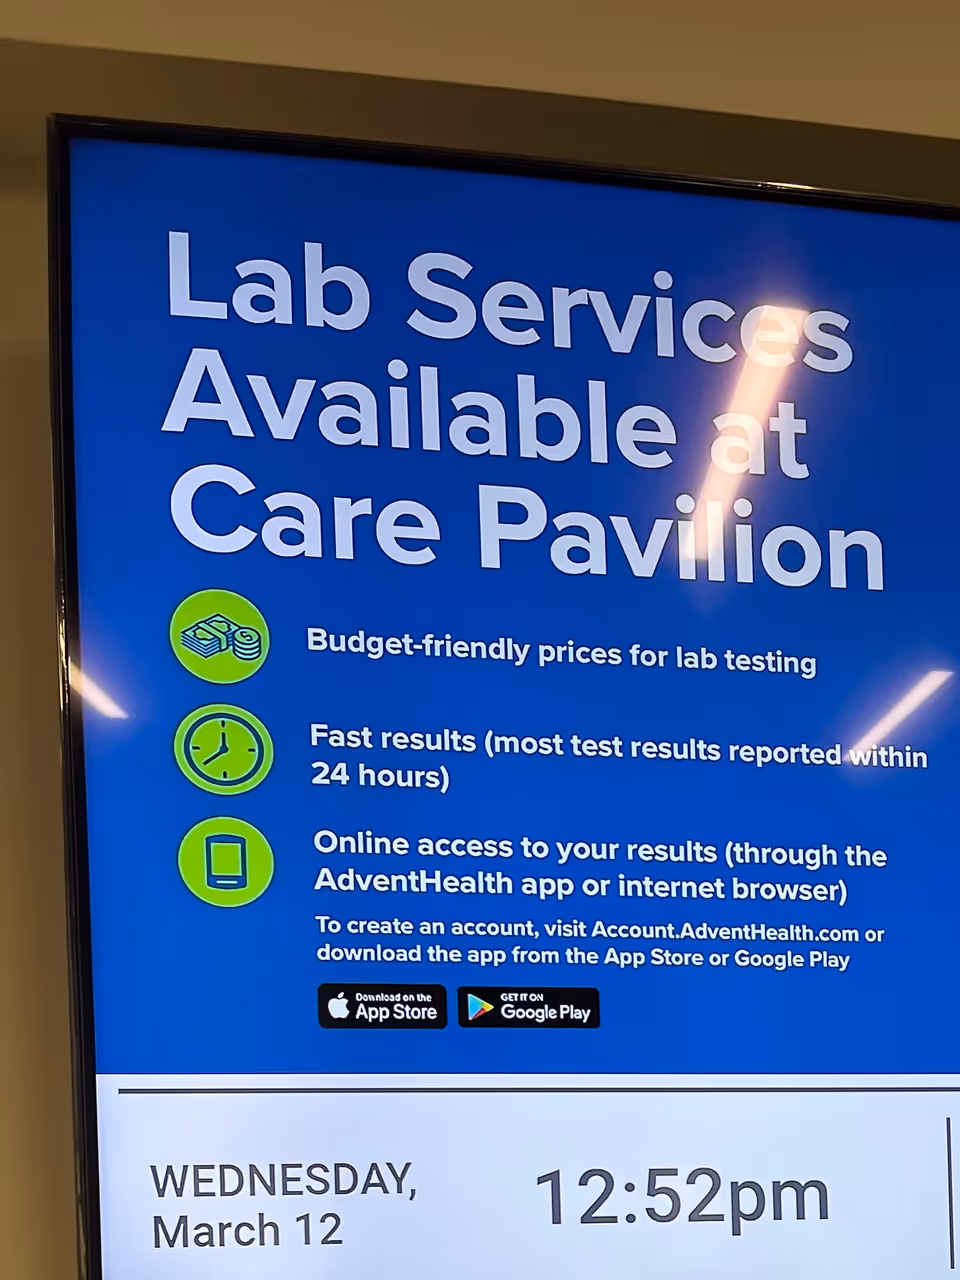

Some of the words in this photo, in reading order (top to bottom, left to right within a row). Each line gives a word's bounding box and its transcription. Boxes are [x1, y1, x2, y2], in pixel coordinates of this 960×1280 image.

[168, 231, 370, 331] Lab
[407, 253, 854, 373] Services
[161, 349, 677, 469] Available
[711, 402, 809, 479] at
[170, 463, 441, 566] Care
[478, 484, 884, 591] Pavilion
[306, 628, 531, 666] Budget-friendly
[539, 639, 622, 669] prices
[629, 642, 669, 668] for
[676, 644, 718, 670] lab
[724, 649, 818, 680] testing
[310, 723, 374, 750] Fast
[381, 728, 477, 754] results
[484, 729, 564, 759] (most
[570, 734, 623, 759] test
[630, 734, 721, 762] results
[728, 739, 842, 768] reported
[849, 742, 928, 769] within
[311, 761, 350, 785] 24
[358, 762, 451, 794] hours)
[313, 830, 409, 855] Online
[417, 838, 513, 858] access
[521, 839, 550, 859] to
[556, 842, 620, 865] your
[627, 841, 717, 864] results
[724, 841, 838, 871] (through
[844, 846, 888, 868] the
[313, 868, 513, 895] AdventHealth
[521, 877, 574, 901] app
[582, 879, 612, 898] or
[618, 875, 725, 900] internet
[732, 877, 848, 906] browser)
[315, 916, 340, 934] To
[346, 918, 414, 936] create
[419, 921, 446, 936] an
[450, 921, 539, 939] account,
[544, 920, 586, 938] visit
[591, 921, 859, 943] Account.AdventHealth.com
[864, 928, 885, 942] or
[316, 944, 422, 964] download
[427, 945, 462, 965] the
[467, 949, 506, 968] app
[511, 946, 560, 964] from
[564, 946, 599, 965] the
[604, 948, 644, 969] App
[650, 948, 704, 967] Store
[708, 952, 729, 967] or
[734, 950, 804, 970] Google
[809, 951, 850, 971] Play
[356, 992, 401, 1002] Download
[403, 994, 414, 1002] on
[416, 993, 432, 1002] the
[356, 1004, 390, 1022] App
[393, 1004, 437, 1020] Store
[501, 994, 519, 1002] GET
[521, 994, 528, 1002] IT
[530, 994, 543, 1002] ON
[501, 1004, 557, 1022] Google
[560, 1004, 590, 1022] Play
[149, 1161, 417, 1202] WEDNESDAY,
[536, 1167, 829, 1237] 12:52pm
[154, 1212, 280, 1249] March
[295, 1212, 343, 1246] 12
